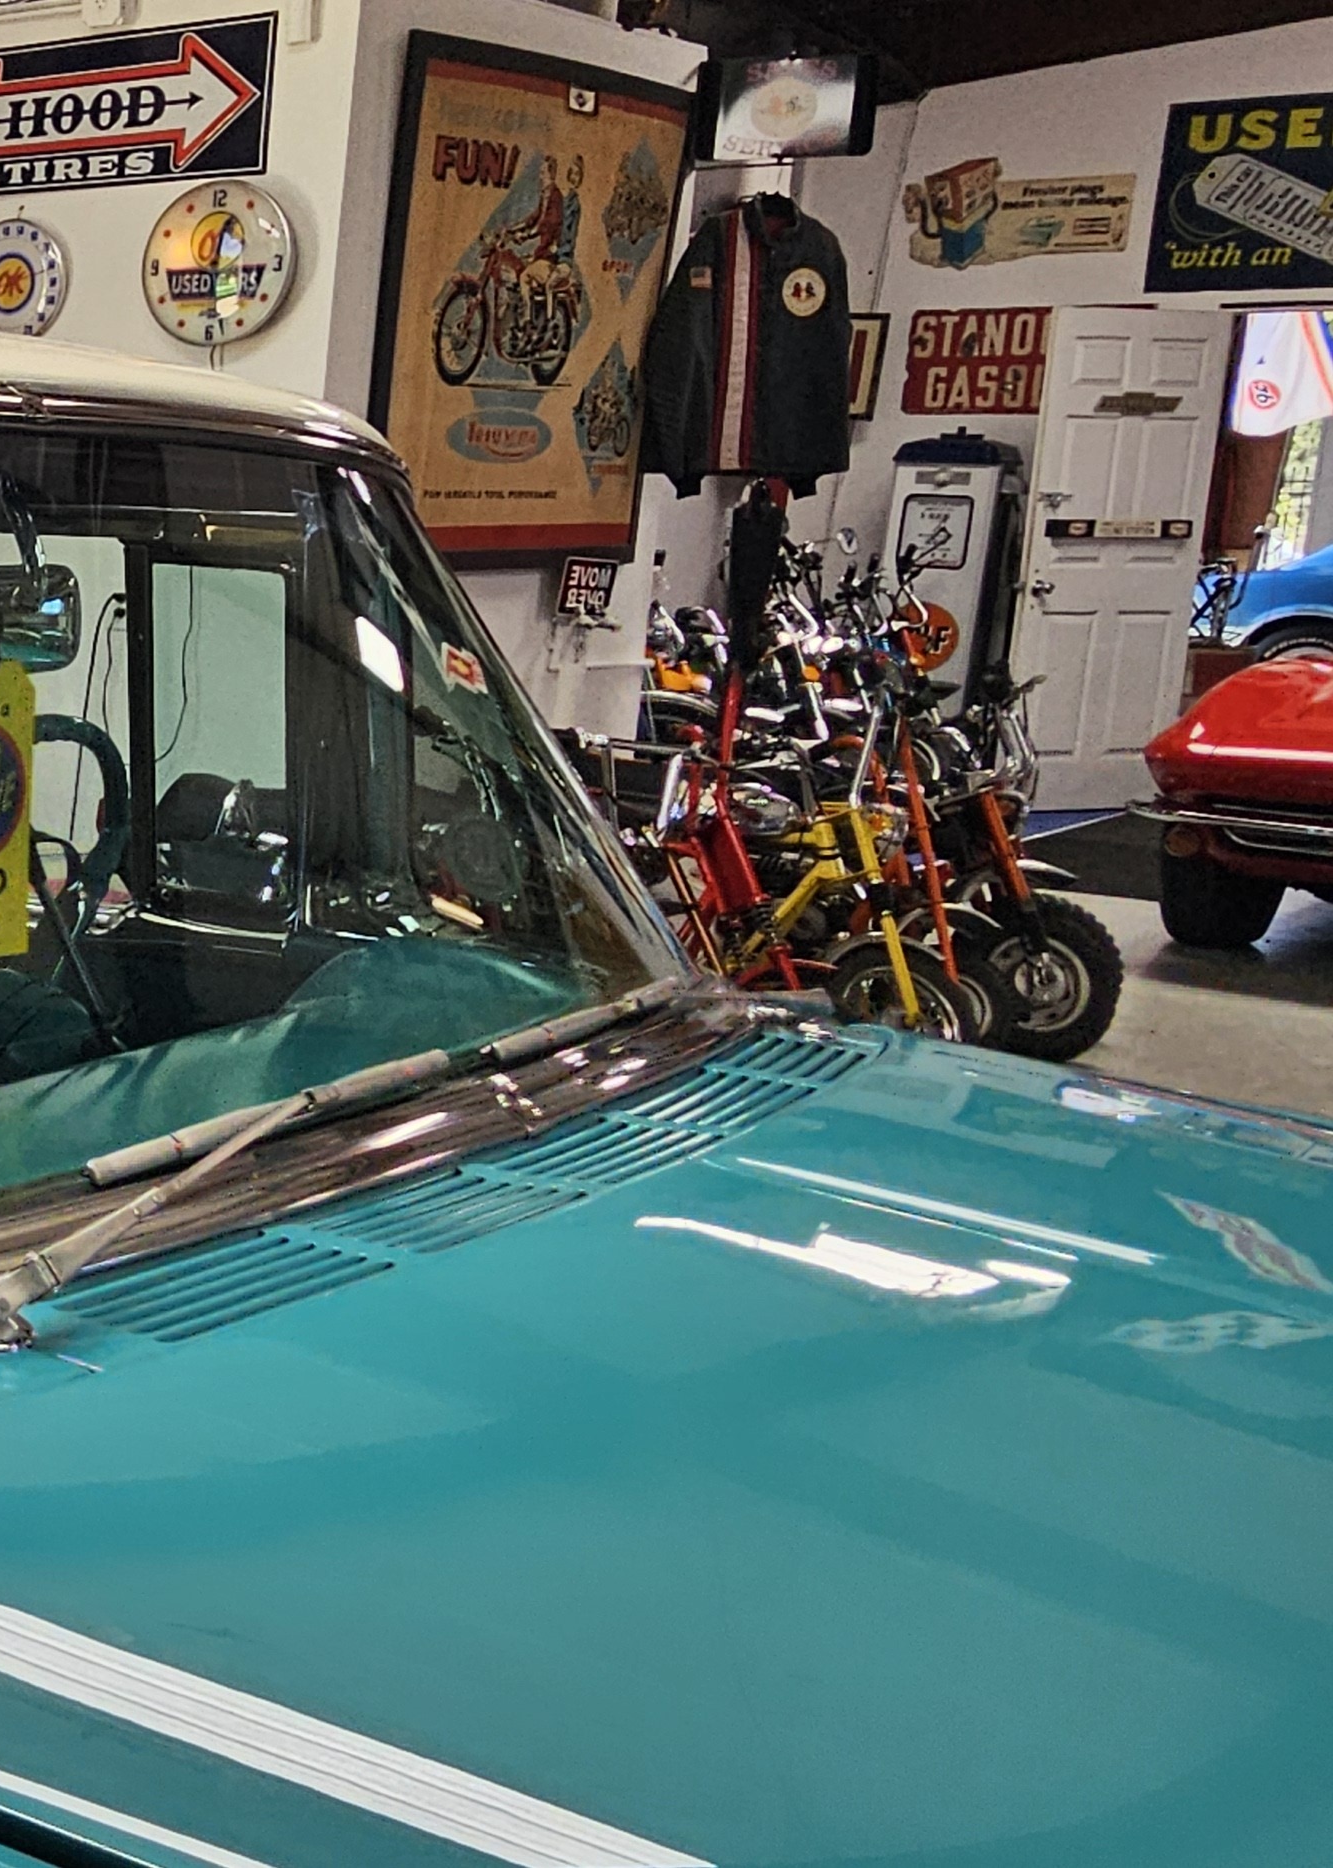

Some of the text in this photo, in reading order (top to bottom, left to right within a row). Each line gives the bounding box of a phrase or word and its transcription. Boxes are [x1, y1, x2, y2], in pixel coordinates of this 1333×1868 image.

[4, 85, 167, 141] HOOD
[1188, 106, 1333, 153] USE
[3, 151, 155, 185] TIRES
[432, 133, 522, 189] FUN!
[212, 189, 228, 208] 12
[272, 254, 283, 272] 3
[1250, 246, 1293, 266] an
[150, 259, 159, 276] 9
[170, 273, 211, 295] USED
[204, 325, 214, 341] 6
